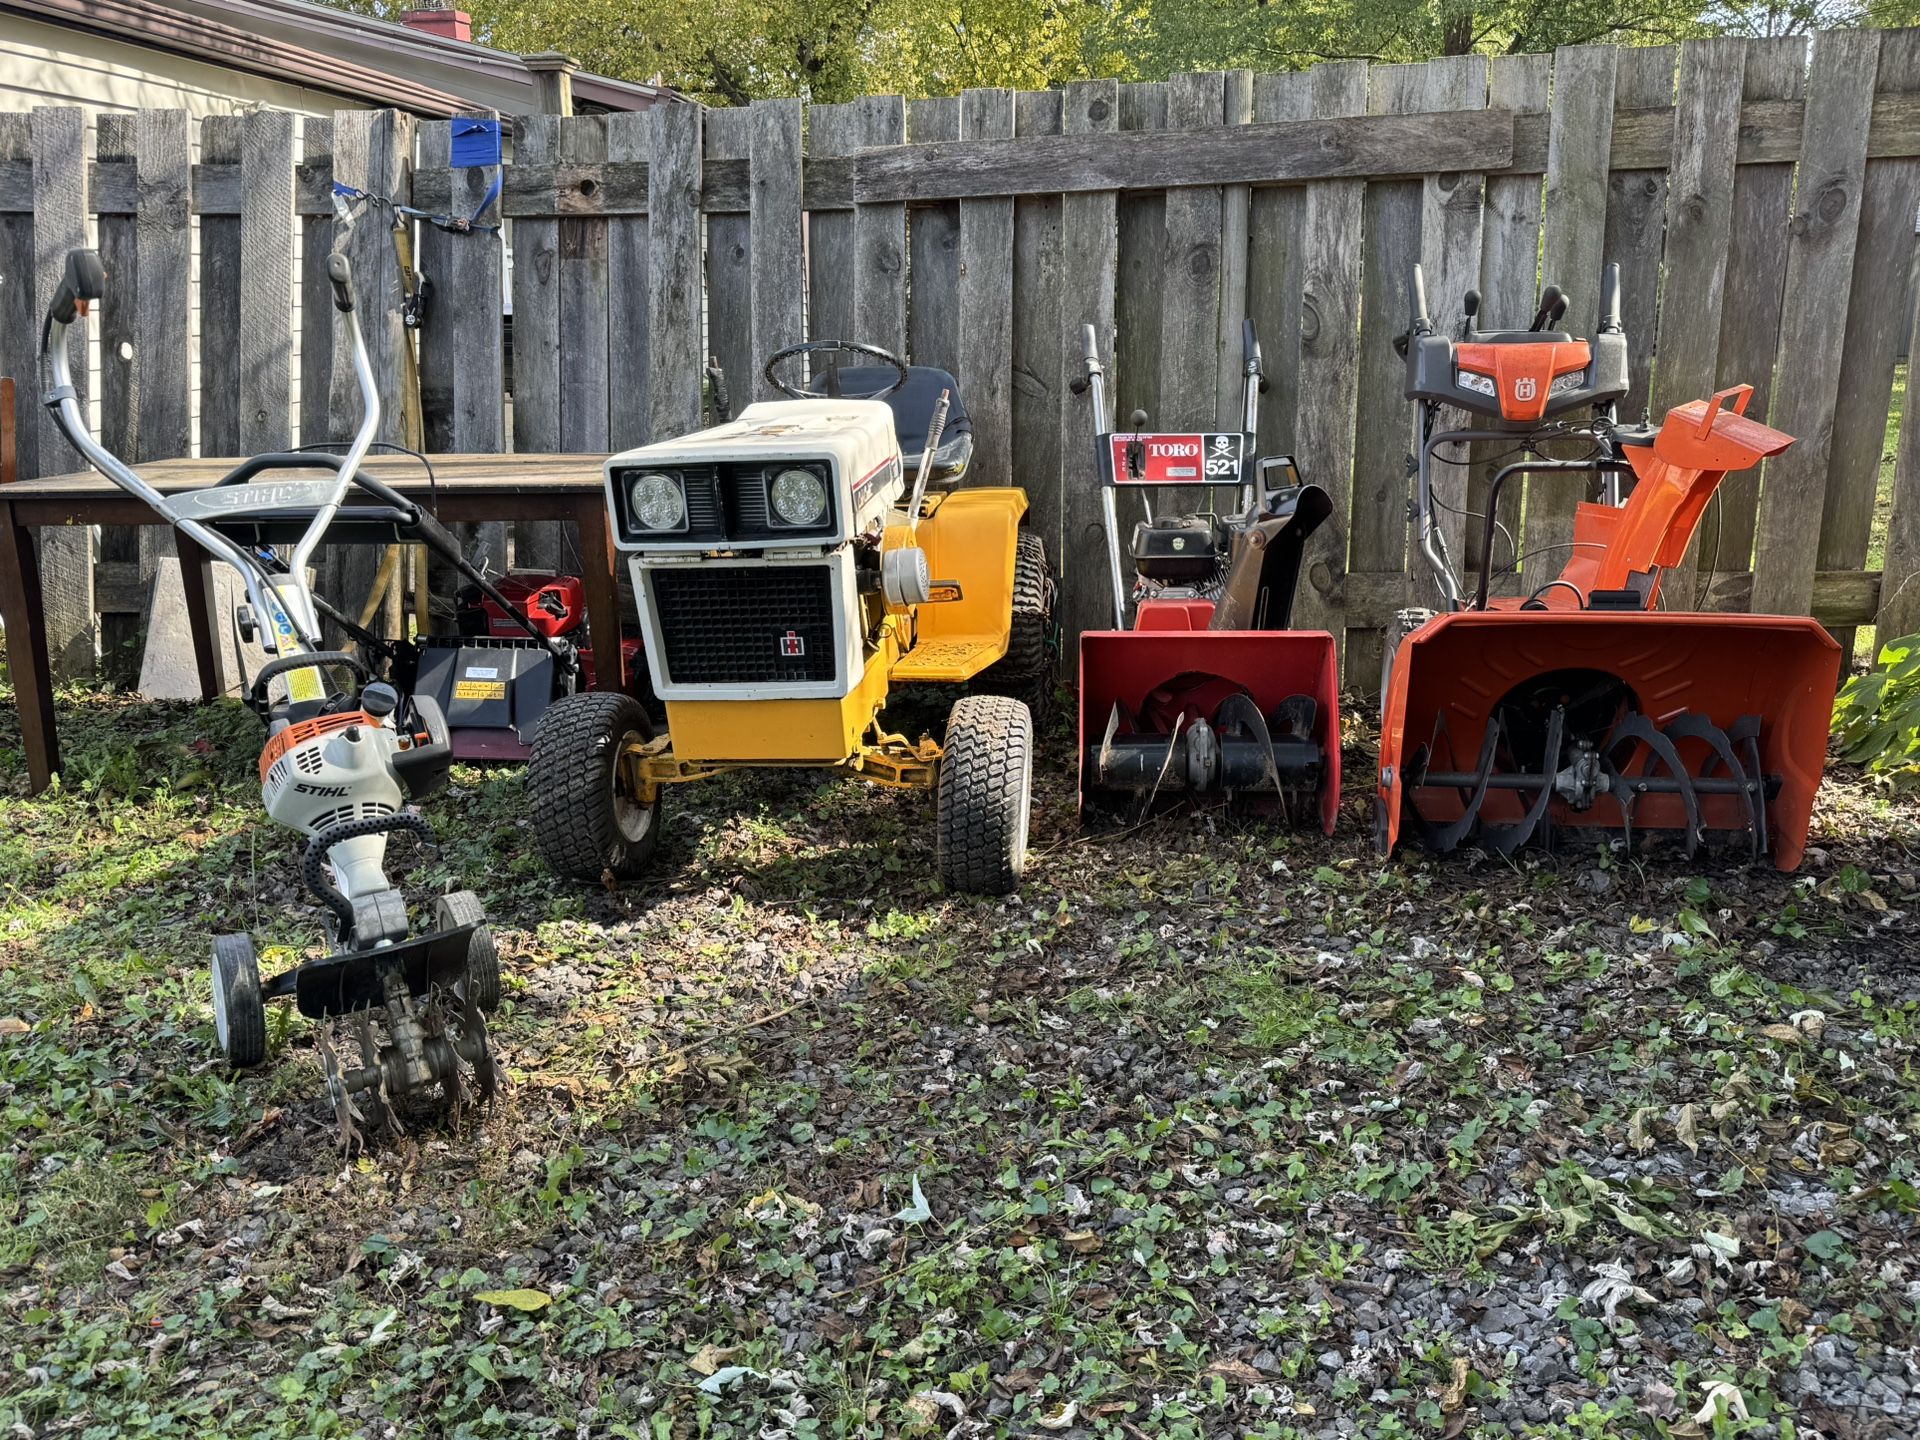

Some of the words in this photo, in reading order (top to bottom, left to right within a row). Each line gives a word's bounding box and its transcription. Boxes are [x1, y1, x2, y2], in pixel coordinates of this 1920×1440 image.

[1149, 443, 1198, 457] TORO
[1206, 459, 1239, 475] 521
[222, 486, 294, 505] STIHL
[294, 784, 348, 797] STIHL
